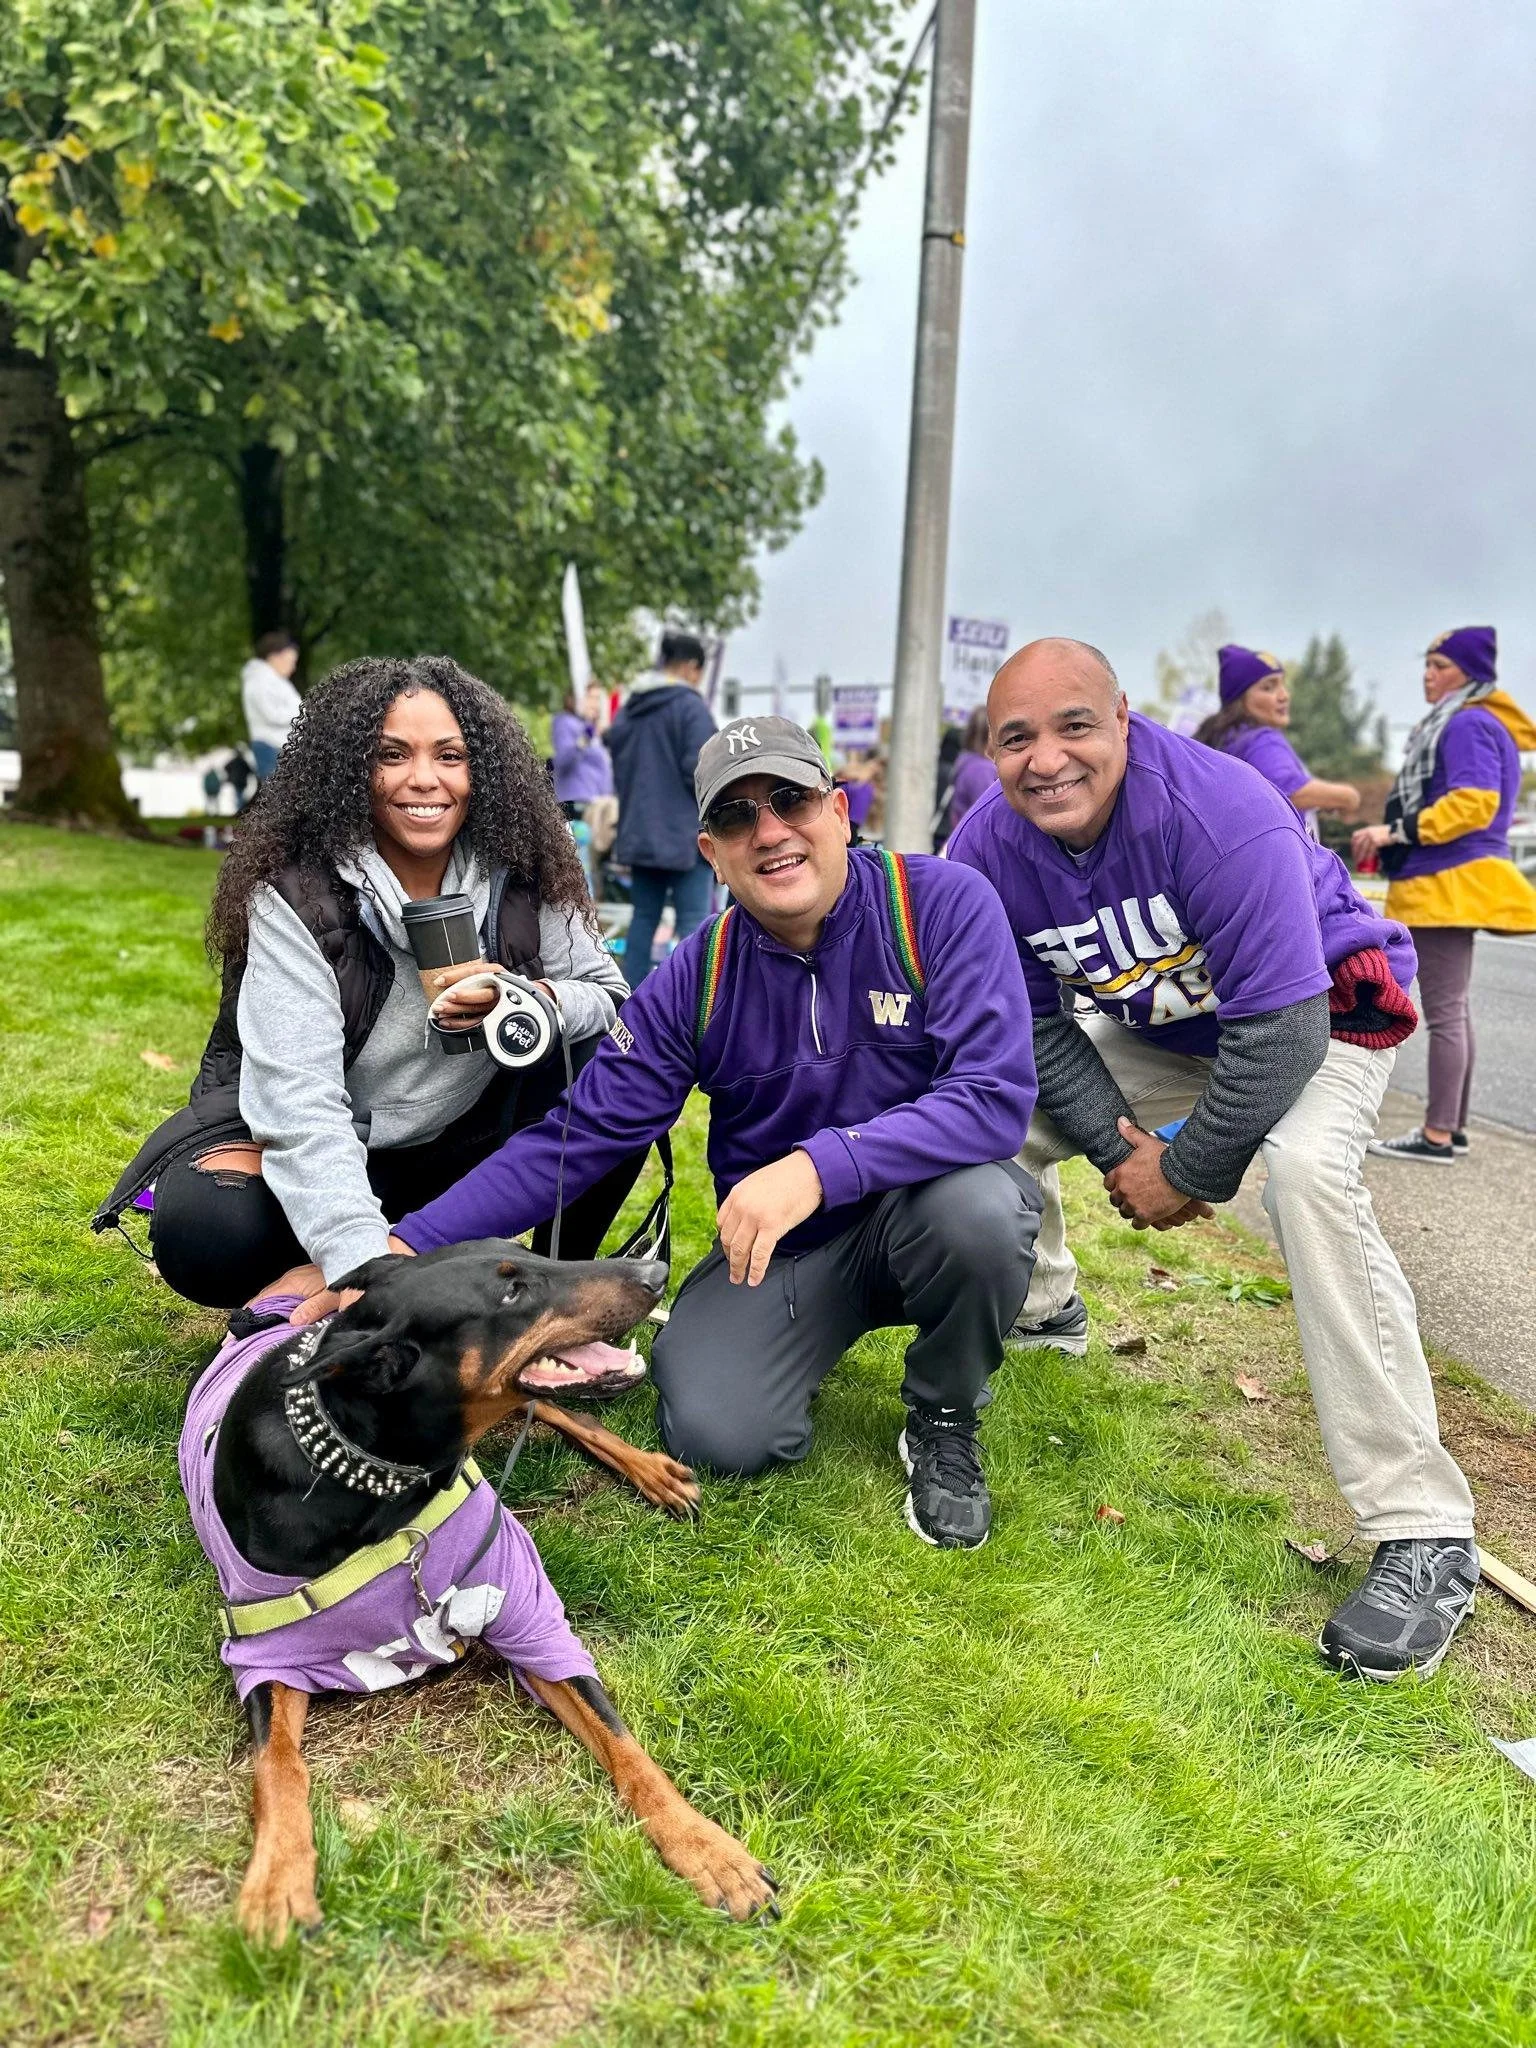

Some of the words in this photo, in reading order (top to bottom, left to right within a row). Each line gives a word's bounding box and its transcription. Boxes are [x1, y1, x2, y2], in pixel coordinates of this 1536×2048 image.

[726, 725, 761, 755] NY
[1023, 893, 1188, 983] SEIU
[868, 990, 911, 1026] W
[512, 1031, 531, 1048] Pet
